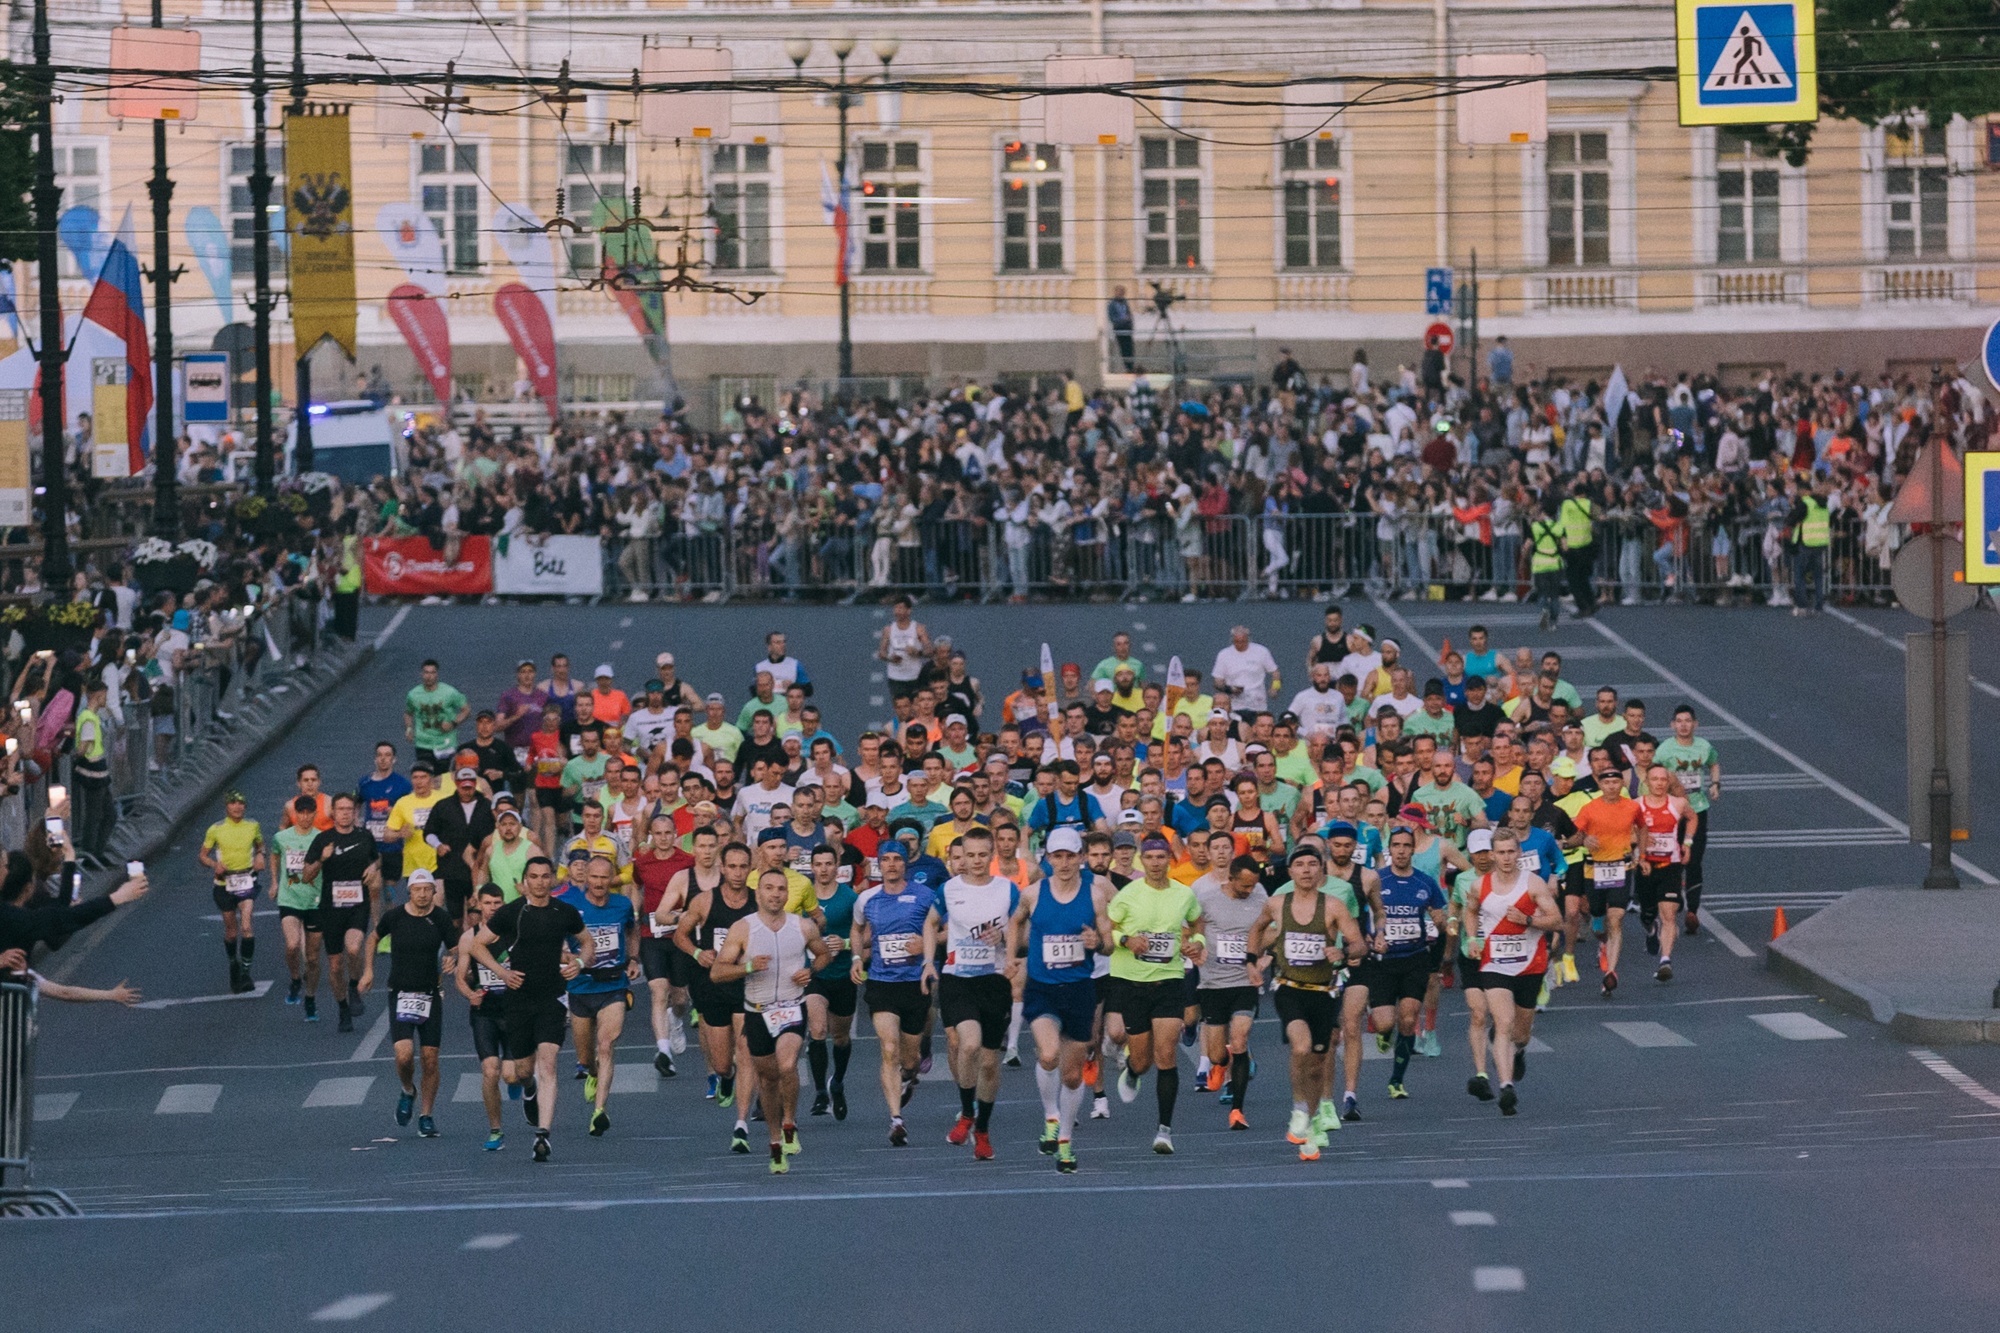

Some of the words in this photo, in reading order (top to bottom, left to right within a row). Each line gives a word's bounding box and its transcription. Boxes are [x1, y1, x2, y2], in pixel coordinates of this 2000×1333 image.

[1602, 868, 1617, 877] 112
[1383, 905, 1418, 915] RUSSIA
[1390, 926, 1415, 935] 5162
[1053, 945, 1074, 956] 811
[1291, 942, 1320, 954] 3249
[1496, 942, 1522, 952] 4770
[960, 947, 988, 959] 3322
